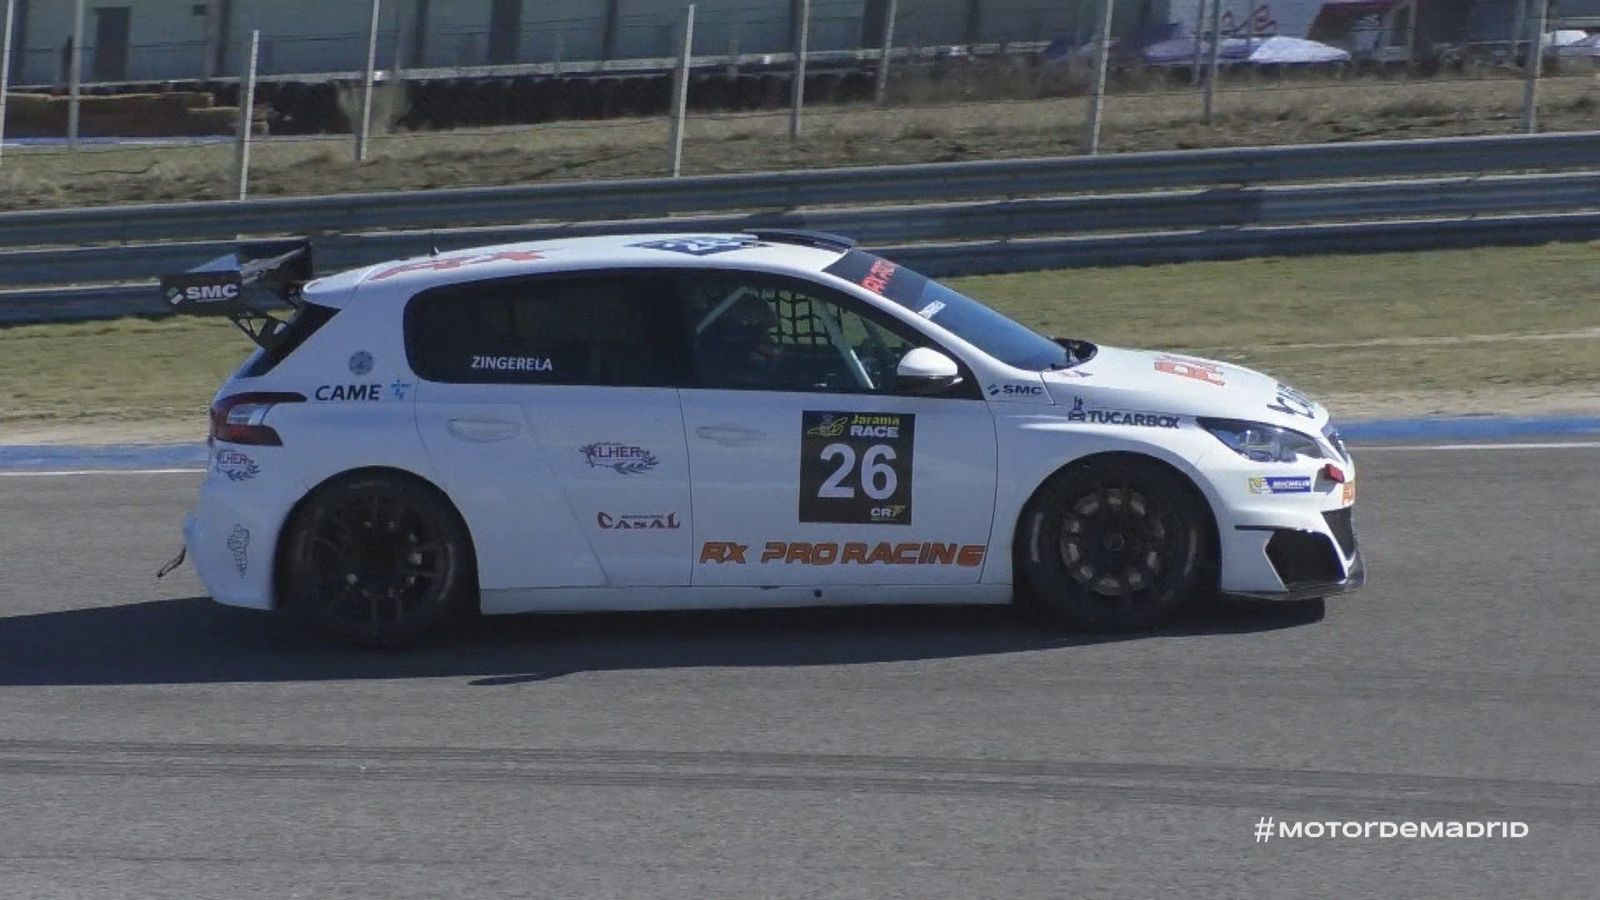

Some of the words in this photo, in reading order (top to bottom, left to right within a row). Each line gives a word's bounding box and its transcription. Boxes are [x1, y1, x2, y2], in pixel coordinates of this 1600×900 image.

[186, 283, 239, 299] SMC
[471, 355, 553, 371] ZINGERELA
[315, 384, 382, 401] CAME
[1002, 384, 1042, 395] SMC
[851, 415, 900, 425] Jarama
[1088, 410, 1180, 429] TUCARBOX
[850, 425, 899, 437] RACE
[817, 443, 898, 500] 26
[699, 541, 748, 564] RX
[761, 541, 838, 566] PRO
[841, 541, 986, 567] RACING
